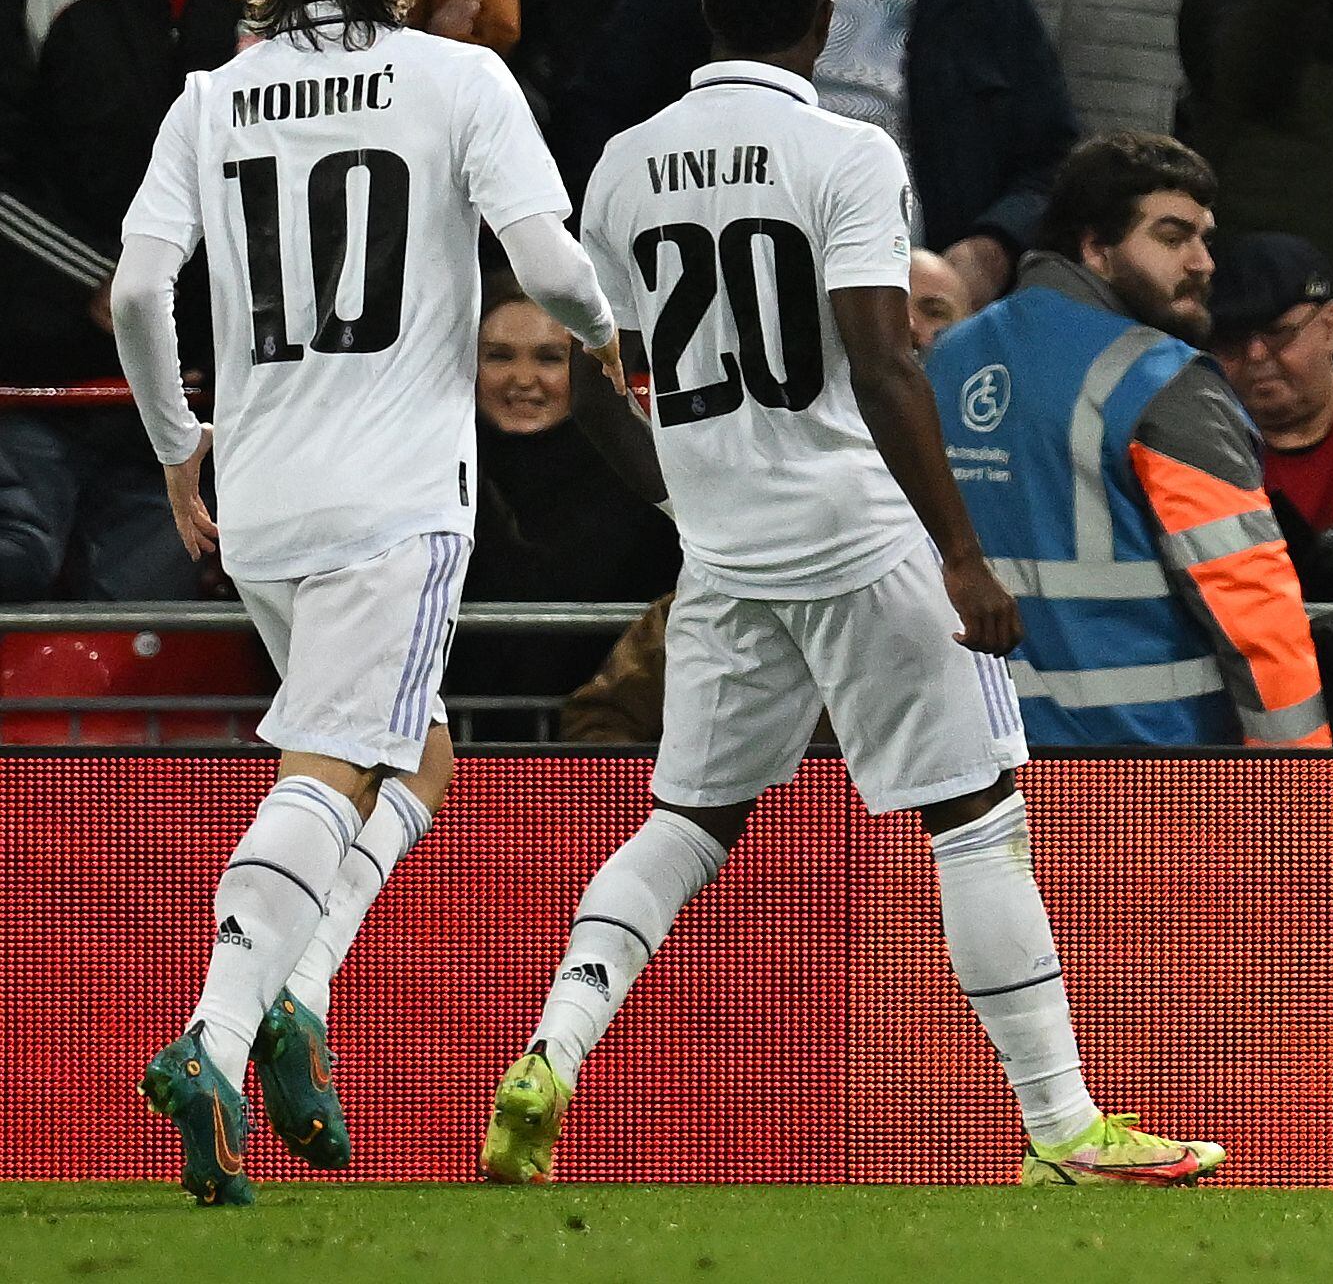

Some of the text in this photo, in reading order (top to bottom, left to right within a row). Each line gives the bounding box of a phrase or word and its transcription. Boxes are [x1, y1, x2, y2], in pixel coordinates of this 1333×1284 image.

[232, 64, 394, 128] MODRIĆ
[222, 148, 410, 366] 10
[633, 217, 824, 429] 20
[562, 967, 611, 1003] adidas
